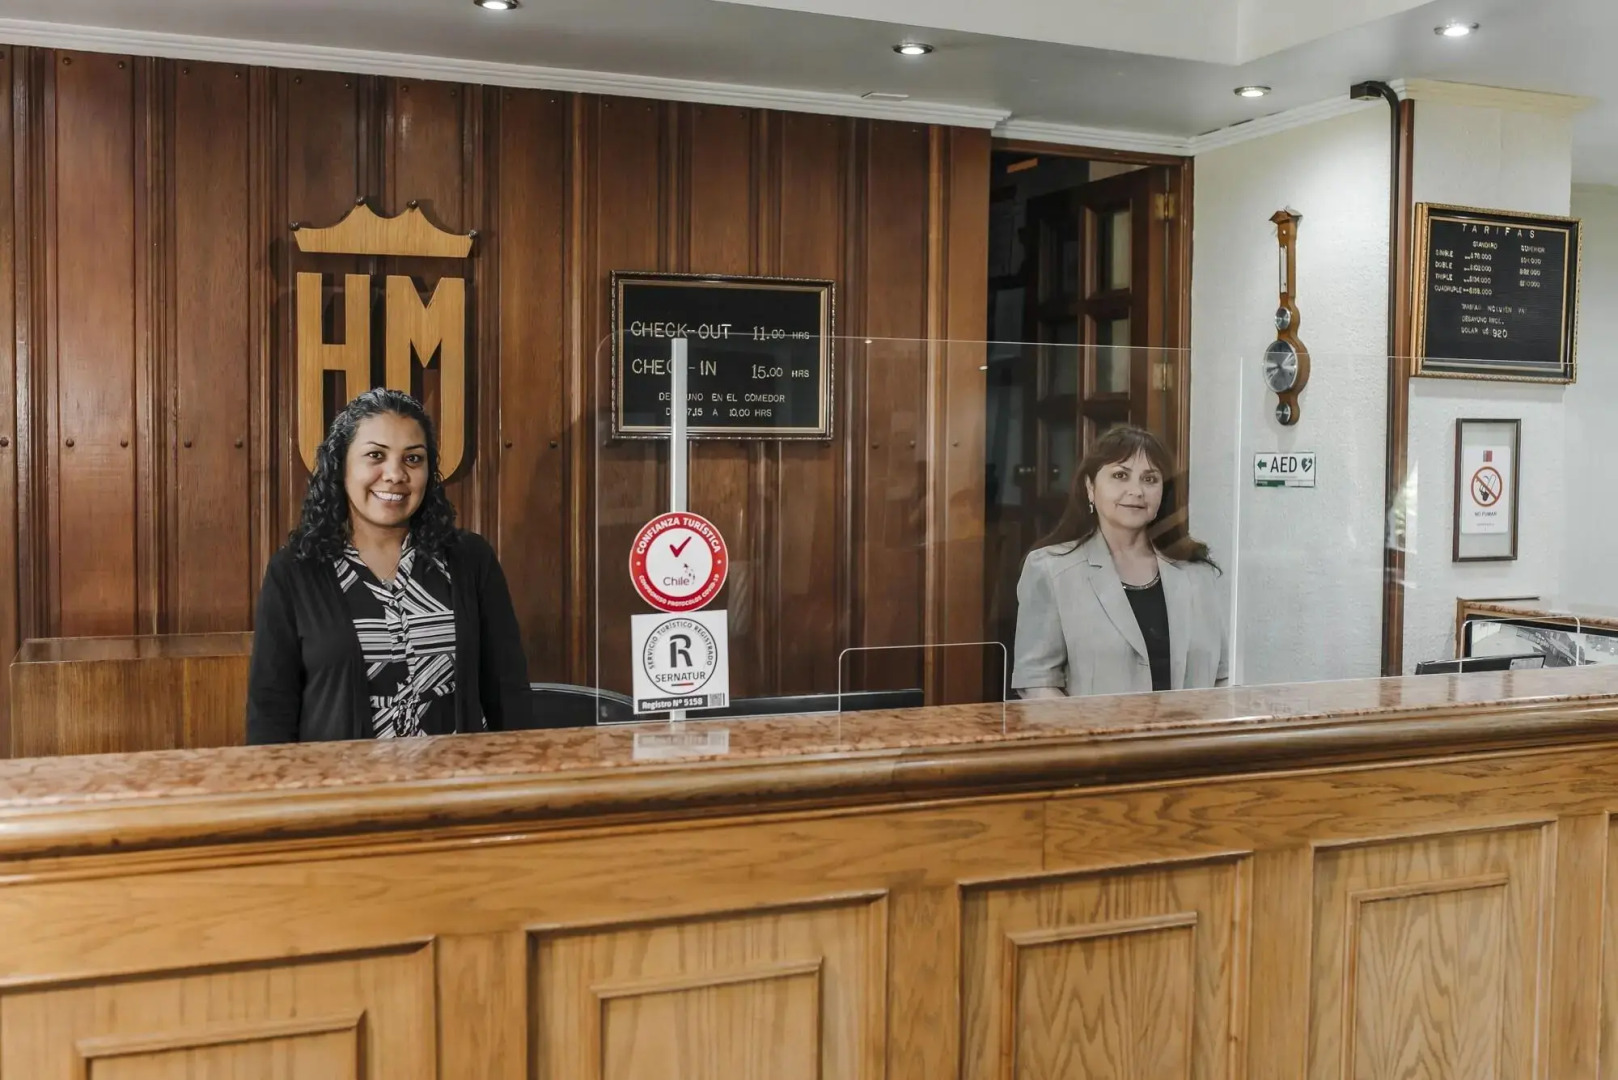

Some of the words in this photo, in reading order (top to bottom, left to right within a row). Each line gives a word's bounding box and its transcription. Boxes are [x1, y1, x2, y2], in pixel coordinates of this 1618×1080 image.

[1462, 224, 1535, 238] TARIFAS
[630, 320, 732, 340] CHECK-OUT
[752, 325, 785, 341] 11.00
[792, 331, 810, 340] HRS
[1492, 328, 1508, 338] 920
[631, 358, 717, 376] CHEC-IN
[751, 363, 784, 379] 15.00
[791, 369, 810, 378] HRS
[659, 392, 704, 401] DEUNO
[711, 392, 723, 402] EN
[727, 392, 738, 402] EL
[744, 393, 785, 403] COMEDOR
[712, 408, 719, 417] A
[754, 408, 772, 418] HRS
[1270, 457, 1297, 473] AED
[636, 517, 681, 555] CONFIANZA
[683, 517, 722, 553] TURÍSTICA
[663, 576, 690, 586] Chile
[647, 636, 658, 670] SERVICIO
[694, 625, 714, 666] REGISTRADO
[669, 633, 693, 668] R
[655, 671, 706, 683] SERNATUR
[642, 700, 672, 711] Registro
[683, 697, 703, 706] 5158
